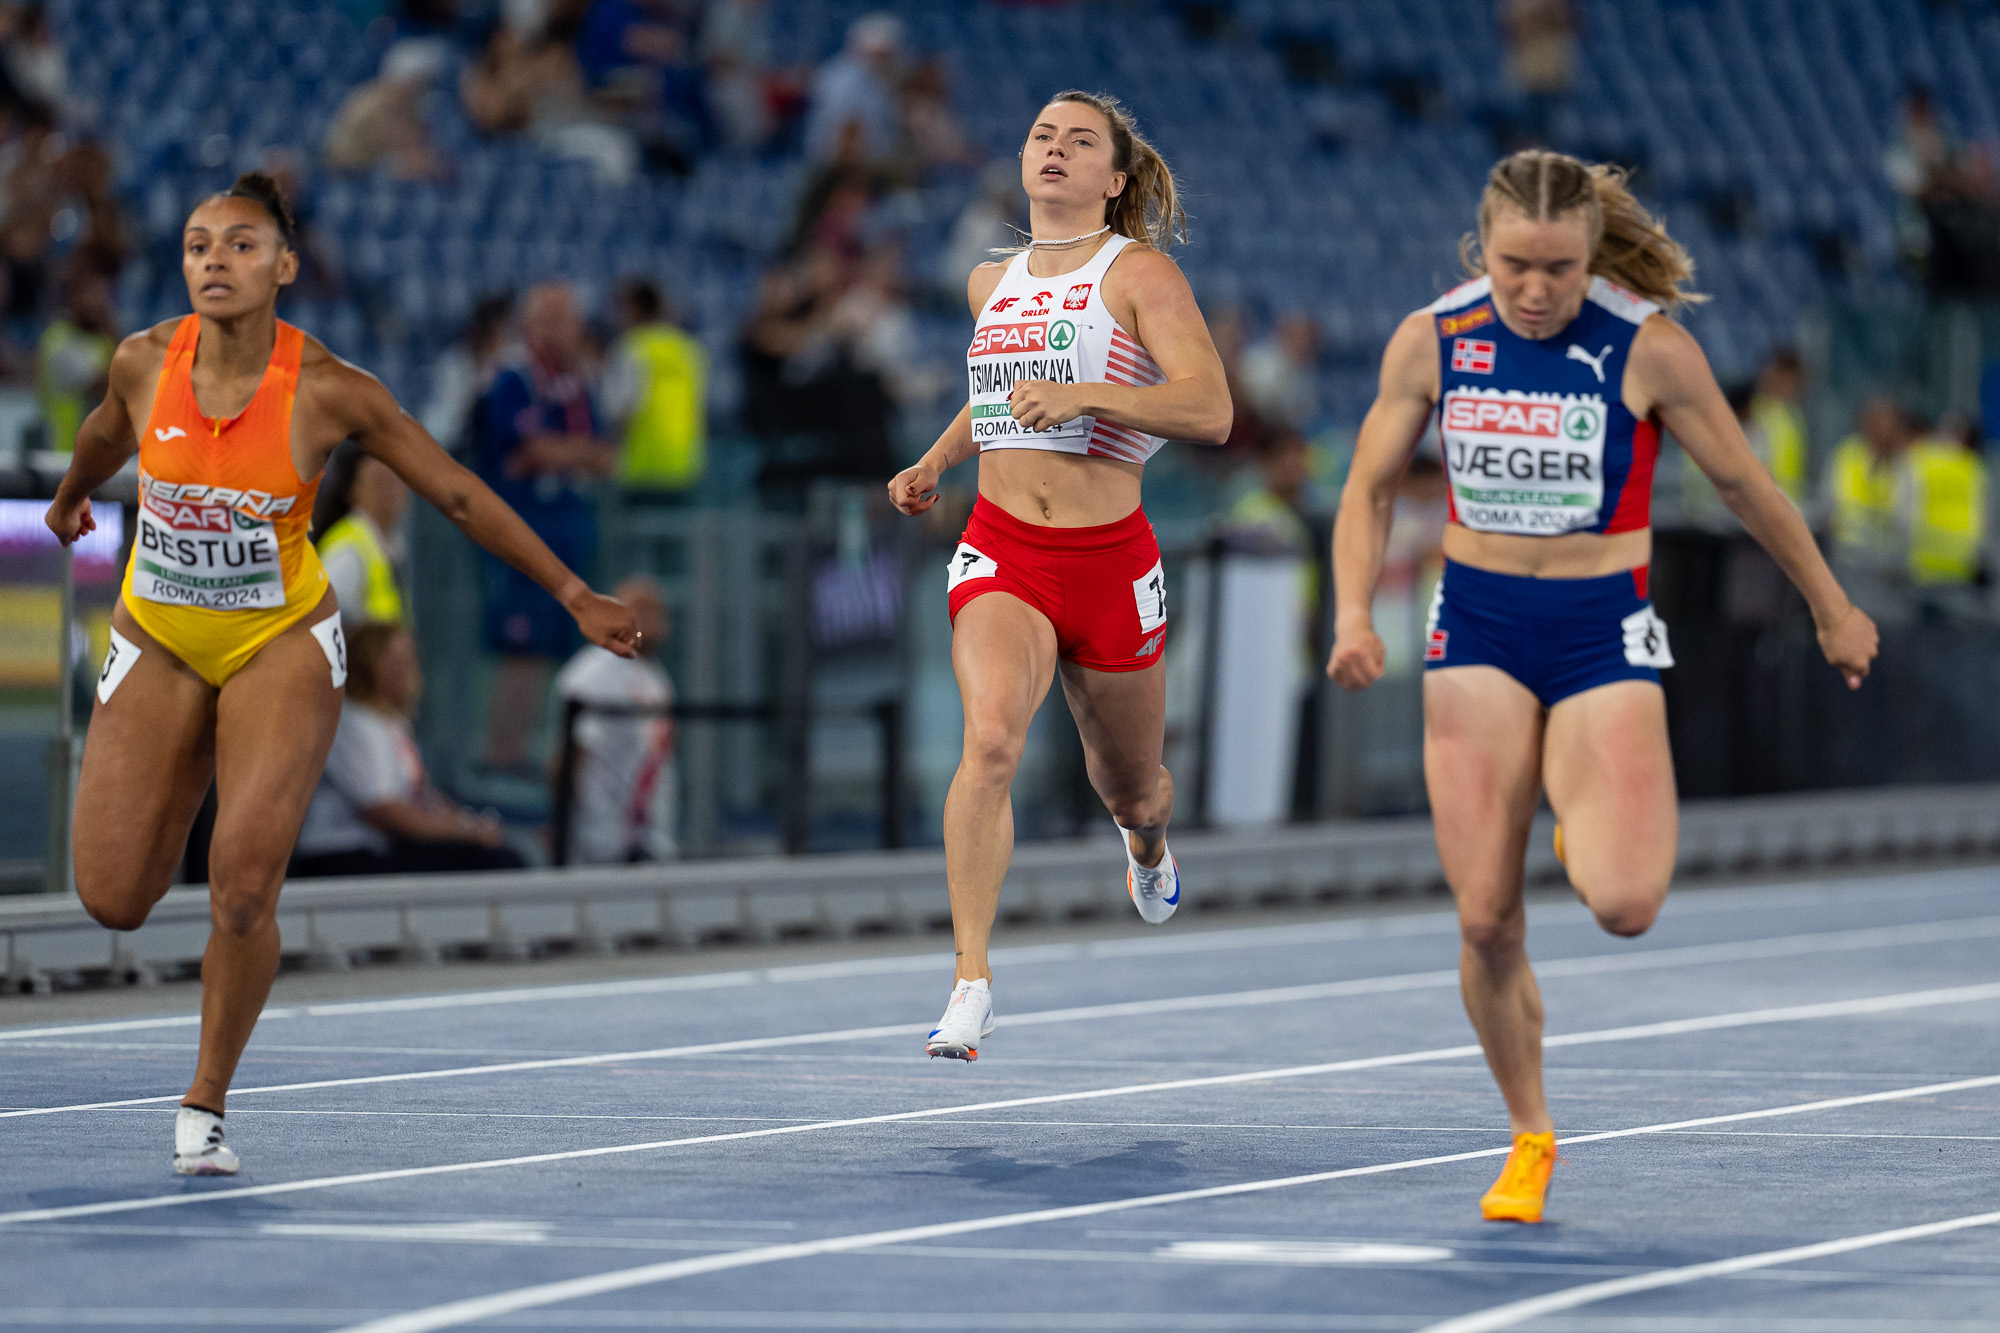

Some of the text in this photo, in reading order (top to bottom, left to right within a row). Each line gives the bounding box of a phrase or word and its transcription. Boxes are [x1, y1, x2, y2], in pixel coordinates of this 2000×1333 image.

[1021, 308, 1050, 317] ORLEN
[971, 325, 1044, 353] SPAR
[970, 358, 1075, 395] TSIMANOUSKAYA
[988, 404, 1010, 416] RUN
[1450, 400, 1559, 435] SPAR
[974, 420, 1019, 437] ROMA
[1451, 441, 1592, 481] JÆGER
[1465, 506, 1525, 528] ROMA
[142, 520, 272, 568] BESTUÉ
[960, 552, 982, 577] 7
[152, 579, 262, 607] ROMA 2024
